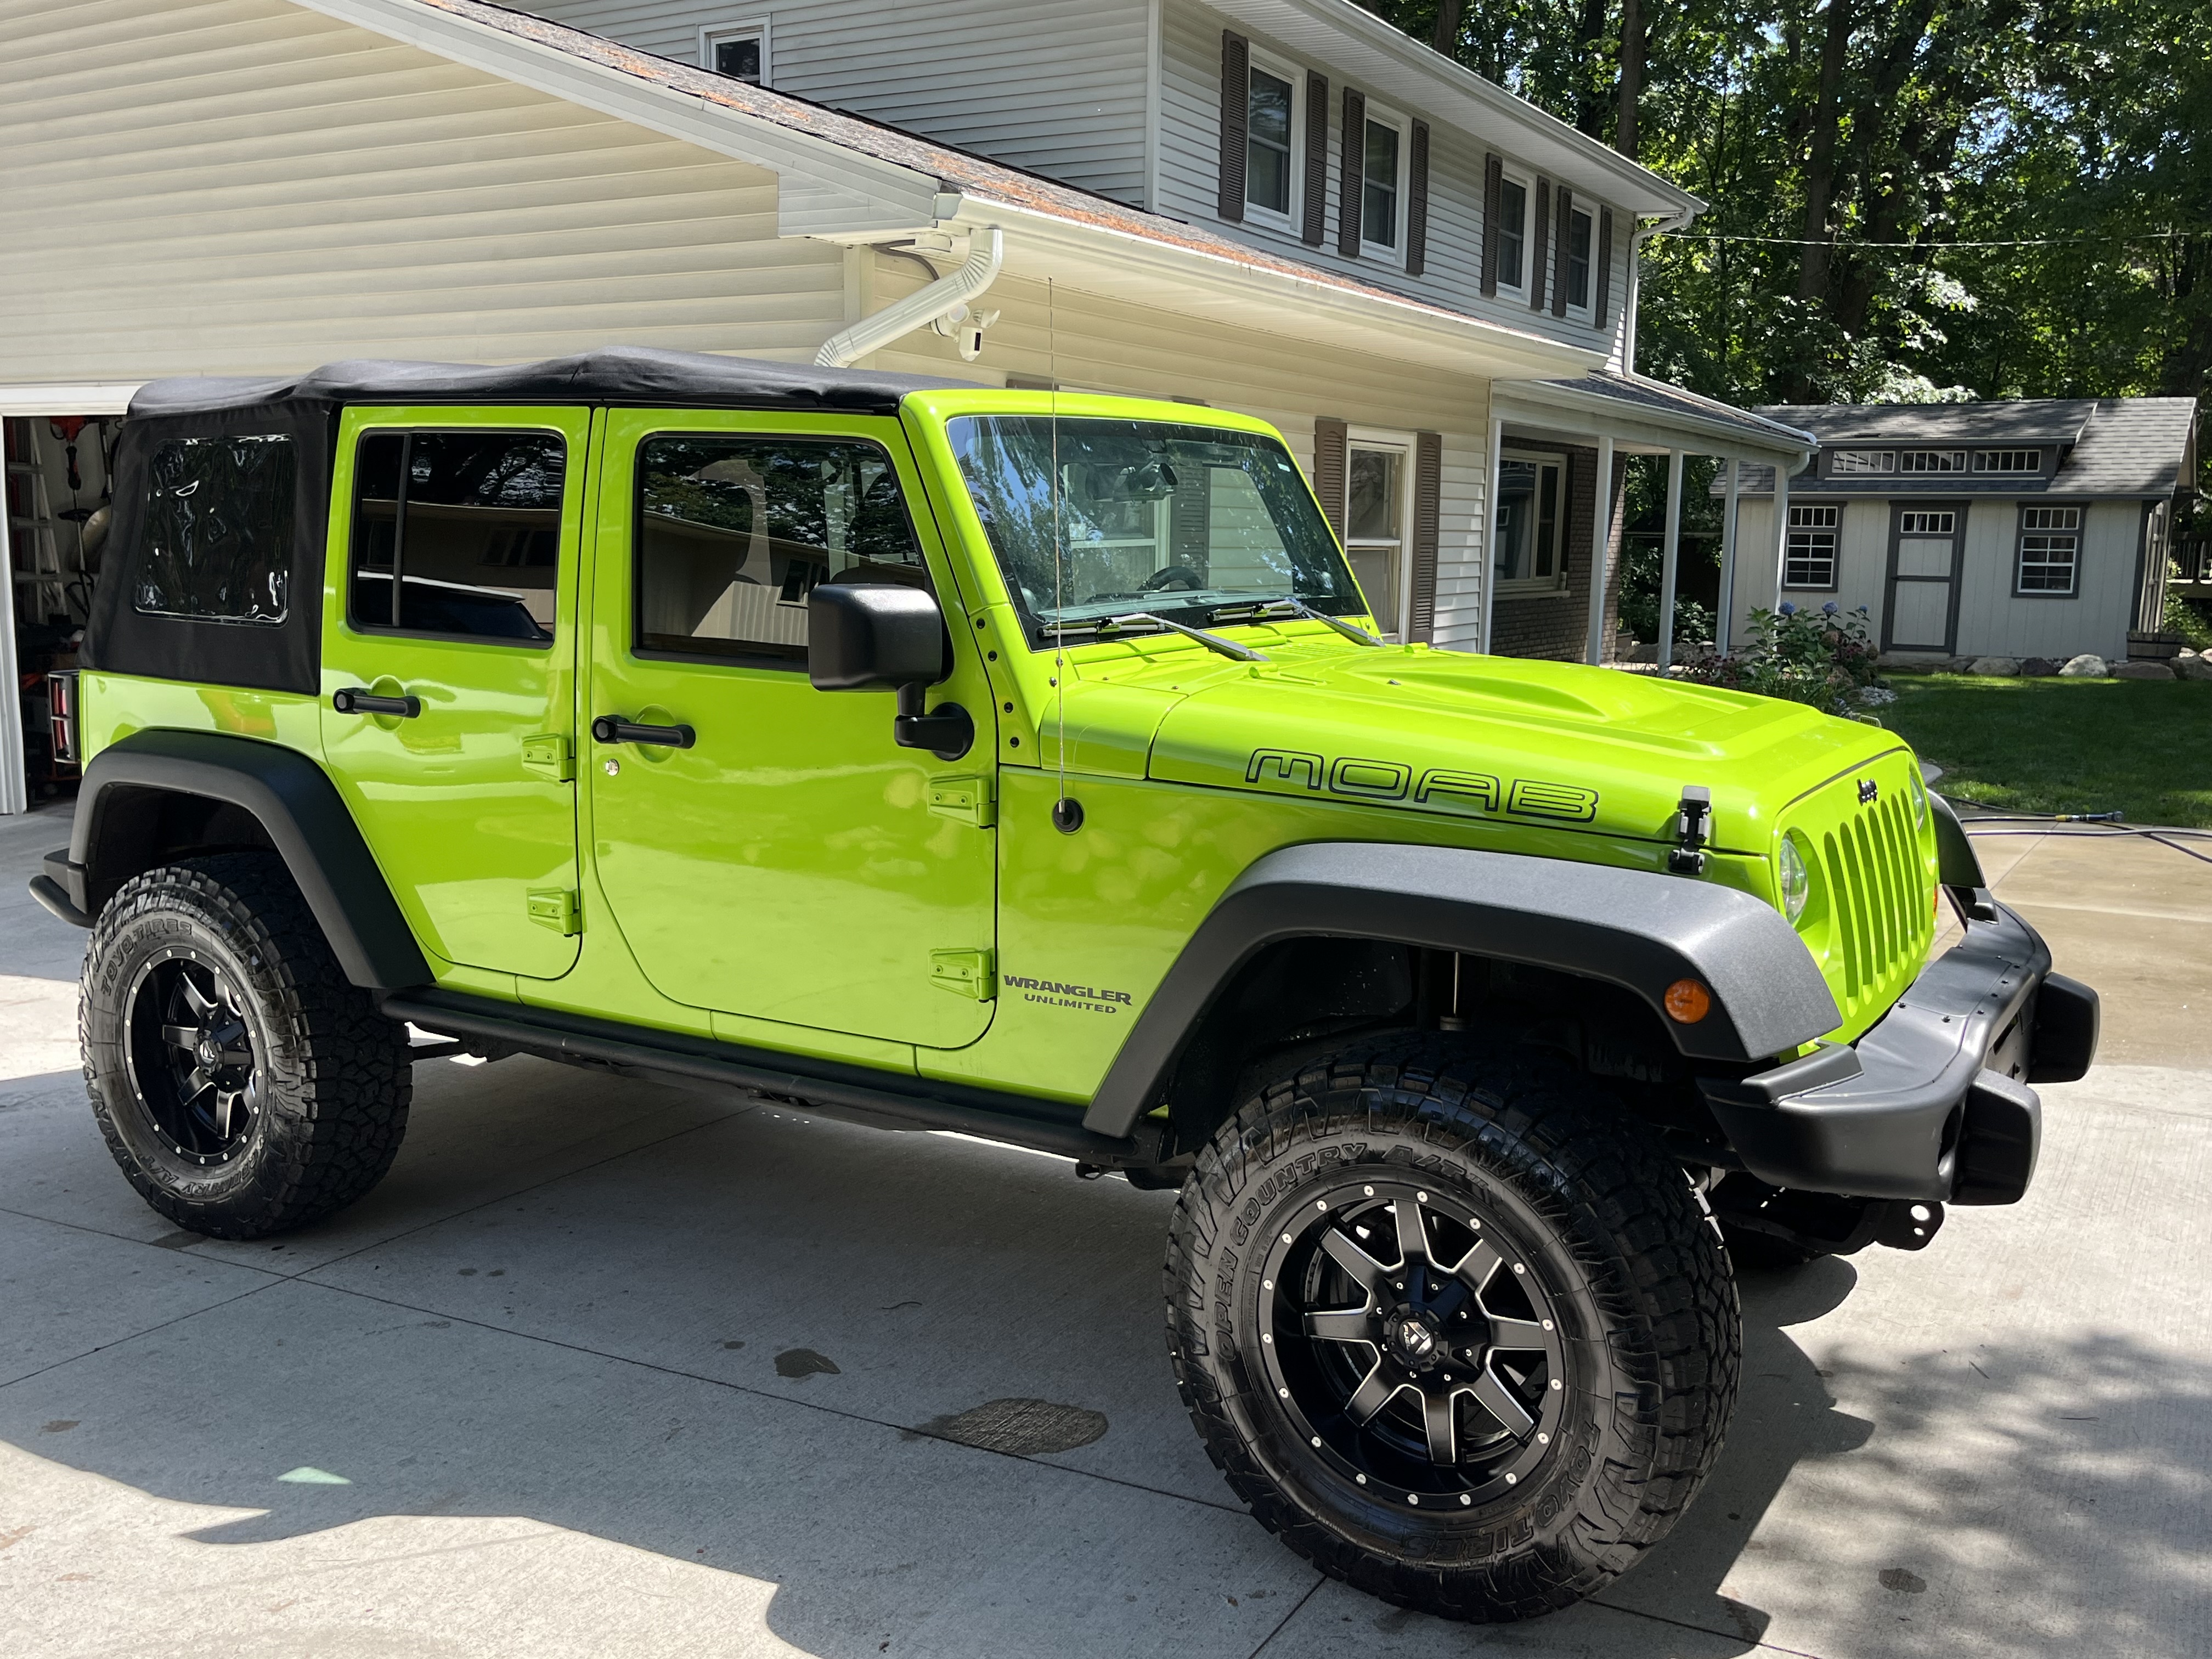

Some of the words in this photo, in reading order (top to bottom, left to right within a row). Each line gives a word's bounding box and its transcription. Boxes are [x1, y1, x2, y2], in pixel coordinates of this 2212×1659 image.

[1245, 748, 1599, 823] MOAB
[101, 934, 133, 996] TOYO
[133, 918, 193, 940] TIRES
[1003, 975, 1132, 1006] WRANGLER
[1024, 994, 1116, 1013] UNLIMITED
[1214, 1246, 1238, 1361] OPEN
[1229, 1143, 1367, 1246] COUNTRY
[1536, 1419, 1601, 1528] TOYO
